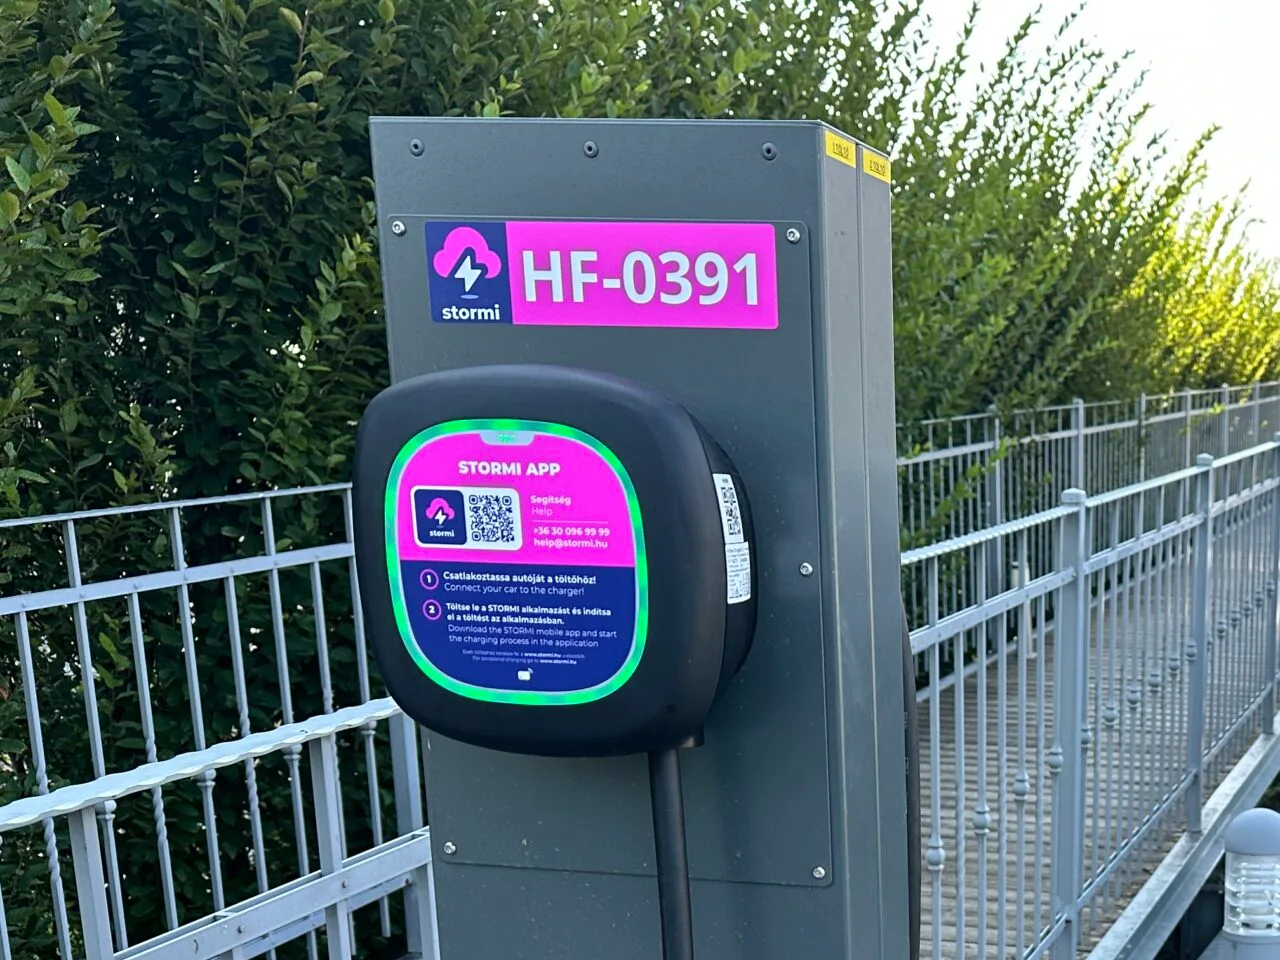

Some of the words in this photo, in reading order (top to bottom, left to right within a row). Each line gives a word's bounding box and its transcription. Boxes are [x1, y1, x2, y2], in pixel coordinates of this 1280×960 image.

[521, 250, 759, 306] HF-0391
[441, 304, 500, 320] stormi
[458, 460, 522, 476] STORMI
[526, 463, 560, 476] APP
[530, 495, 572, 506] Segítség
[532, 507, 553, 517] Help
[533, 526, 550, 536] +36
[551, 527, 563, 536] 30
[584, 528, 596, 536] 99
[598, 528, 610, 536] 99
[534, 538, 608, 549] help@stormi.hu
[426, 575, 432, 584] 1
[443, 571, 510, 582] Csatlakoztassa
[512, 574, 545, 584] autóját
[444, 583, 480, 592] Connect
[482, 585, 502, 594] your
[520, 586, 528, 594] to
[531, 586, 546, 594] the
[548, 587, 584, 597] charger!
[428, 606, 436, 614] 2
[446, 602, 470, 611] Töltse
[488, 604, 520, 613] STORMI
[521, 606, 570, 615] alkalmazást
[572, 606, 582, 615] és
[463, 614, 489, 622] töltést
[502, 614, 565, 625] alkalmazásban.
[448, 624, 488, 633] Download
[488, 626, 502, 634] the
[504, 626, 534, 635] STORMI
[536, 628, 564, 636] mobile
[565, 629, 580, 638] app
[582, 629, 598, 637] and
[599, 630, 616, 638] start
[448, 634, 462, 642] the
[464, 635, 498, 645] charging
[500, 637, 530, 645] process
[540, 638, 554, 646] the
[555, 639, 598, 648] application
